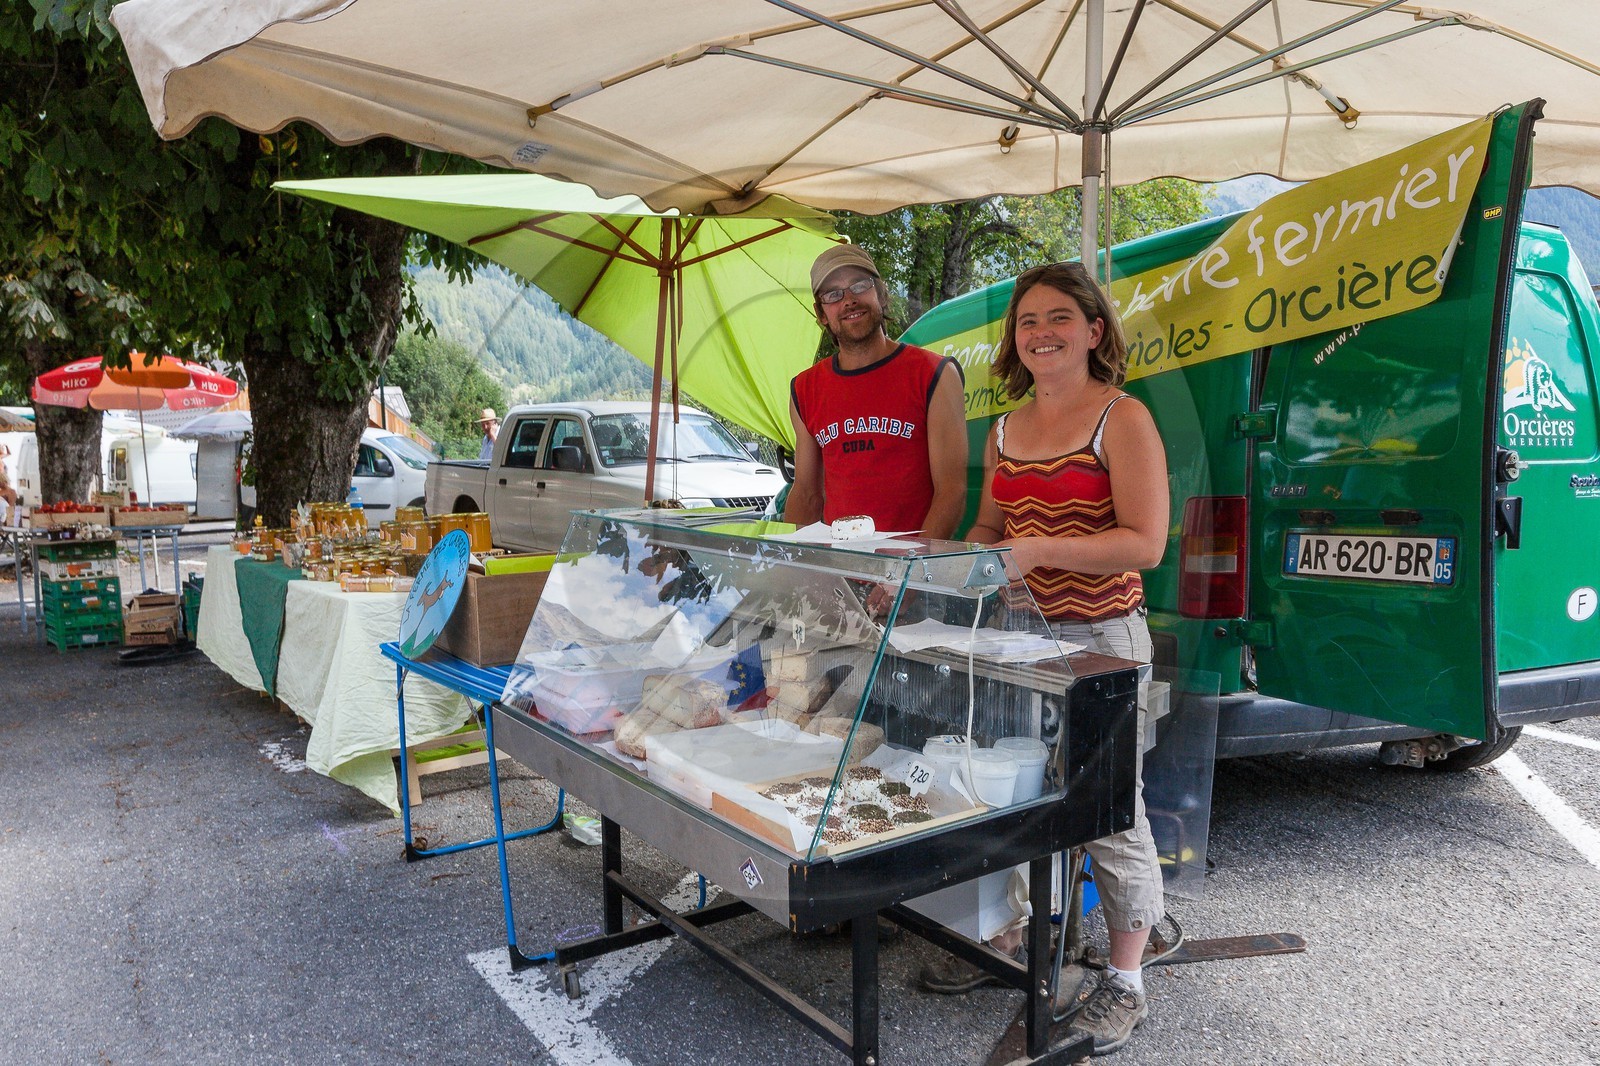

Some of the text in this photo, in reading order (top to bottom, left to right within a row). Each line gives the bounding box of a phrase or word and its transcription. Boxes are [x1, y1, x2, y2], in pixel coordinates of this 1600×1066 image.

[1247, 145, 1475, 277] fermier
[1484, 208, 1501, 218] OMP
[1244, 246, 1449, 333] Orcière
[61, 377, 88, 389] MIKO
[844, 416, 915, 439] CARIBE
[1503, 412, 1575, 437] Orcières
[842, 438, 875, 454] CUBA
[1509, 437, 1574, 446] MERLETTE
[1273, 486, 1303, 496] FIAT
[1299, 538, 1433, 577] AR-620-BR
[1435, 562, 1452, 579] 05
[409, 558, 431, 600] FERME
[1578, 593, 1587, 615] F
[910, 765, 930, 783] 2,20
